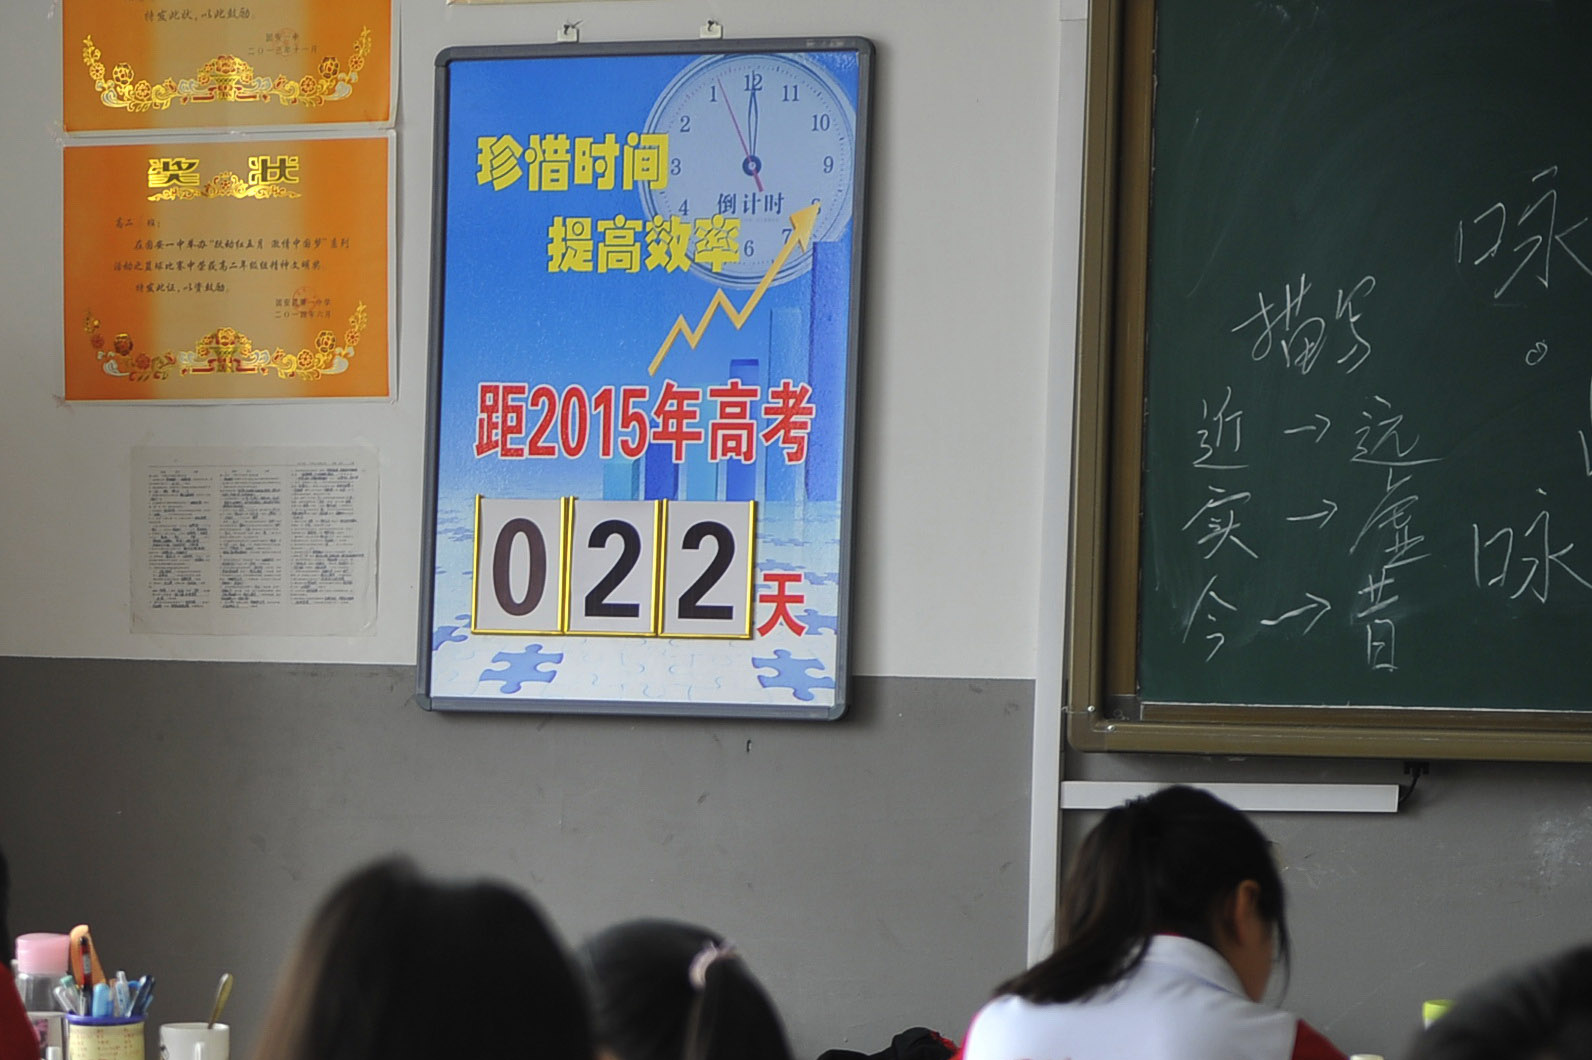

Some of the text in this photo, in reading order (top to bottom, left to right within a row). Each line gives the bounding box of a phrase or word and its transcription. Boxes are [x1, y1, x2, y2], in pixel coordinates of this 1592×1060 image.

[744, 73, 763, 92] 12
[709, 85, 718, 103] 1
[781, 85, 800, 103] 11
[680, 114, 691, 133] 2
[810, 114, 831, 132] 10
[475, 132, 669, 192] 珍惜时间
[670, 158, 682, 176] 3
[823, 156, 834, 174] 9
[679, 198, 689, 217] 4
[716, 191, 785, 216] 倒计时
[546, 214, 741, 274] 提高效率
[743, 239, 755, 257] 6
[475, 378, 815, 463] 距2015年高考
[1191, 386, 1444, 469] 近 远
[1182, 485, 1258, 559] 实
[1357, 573, 1400, 672] 昔
